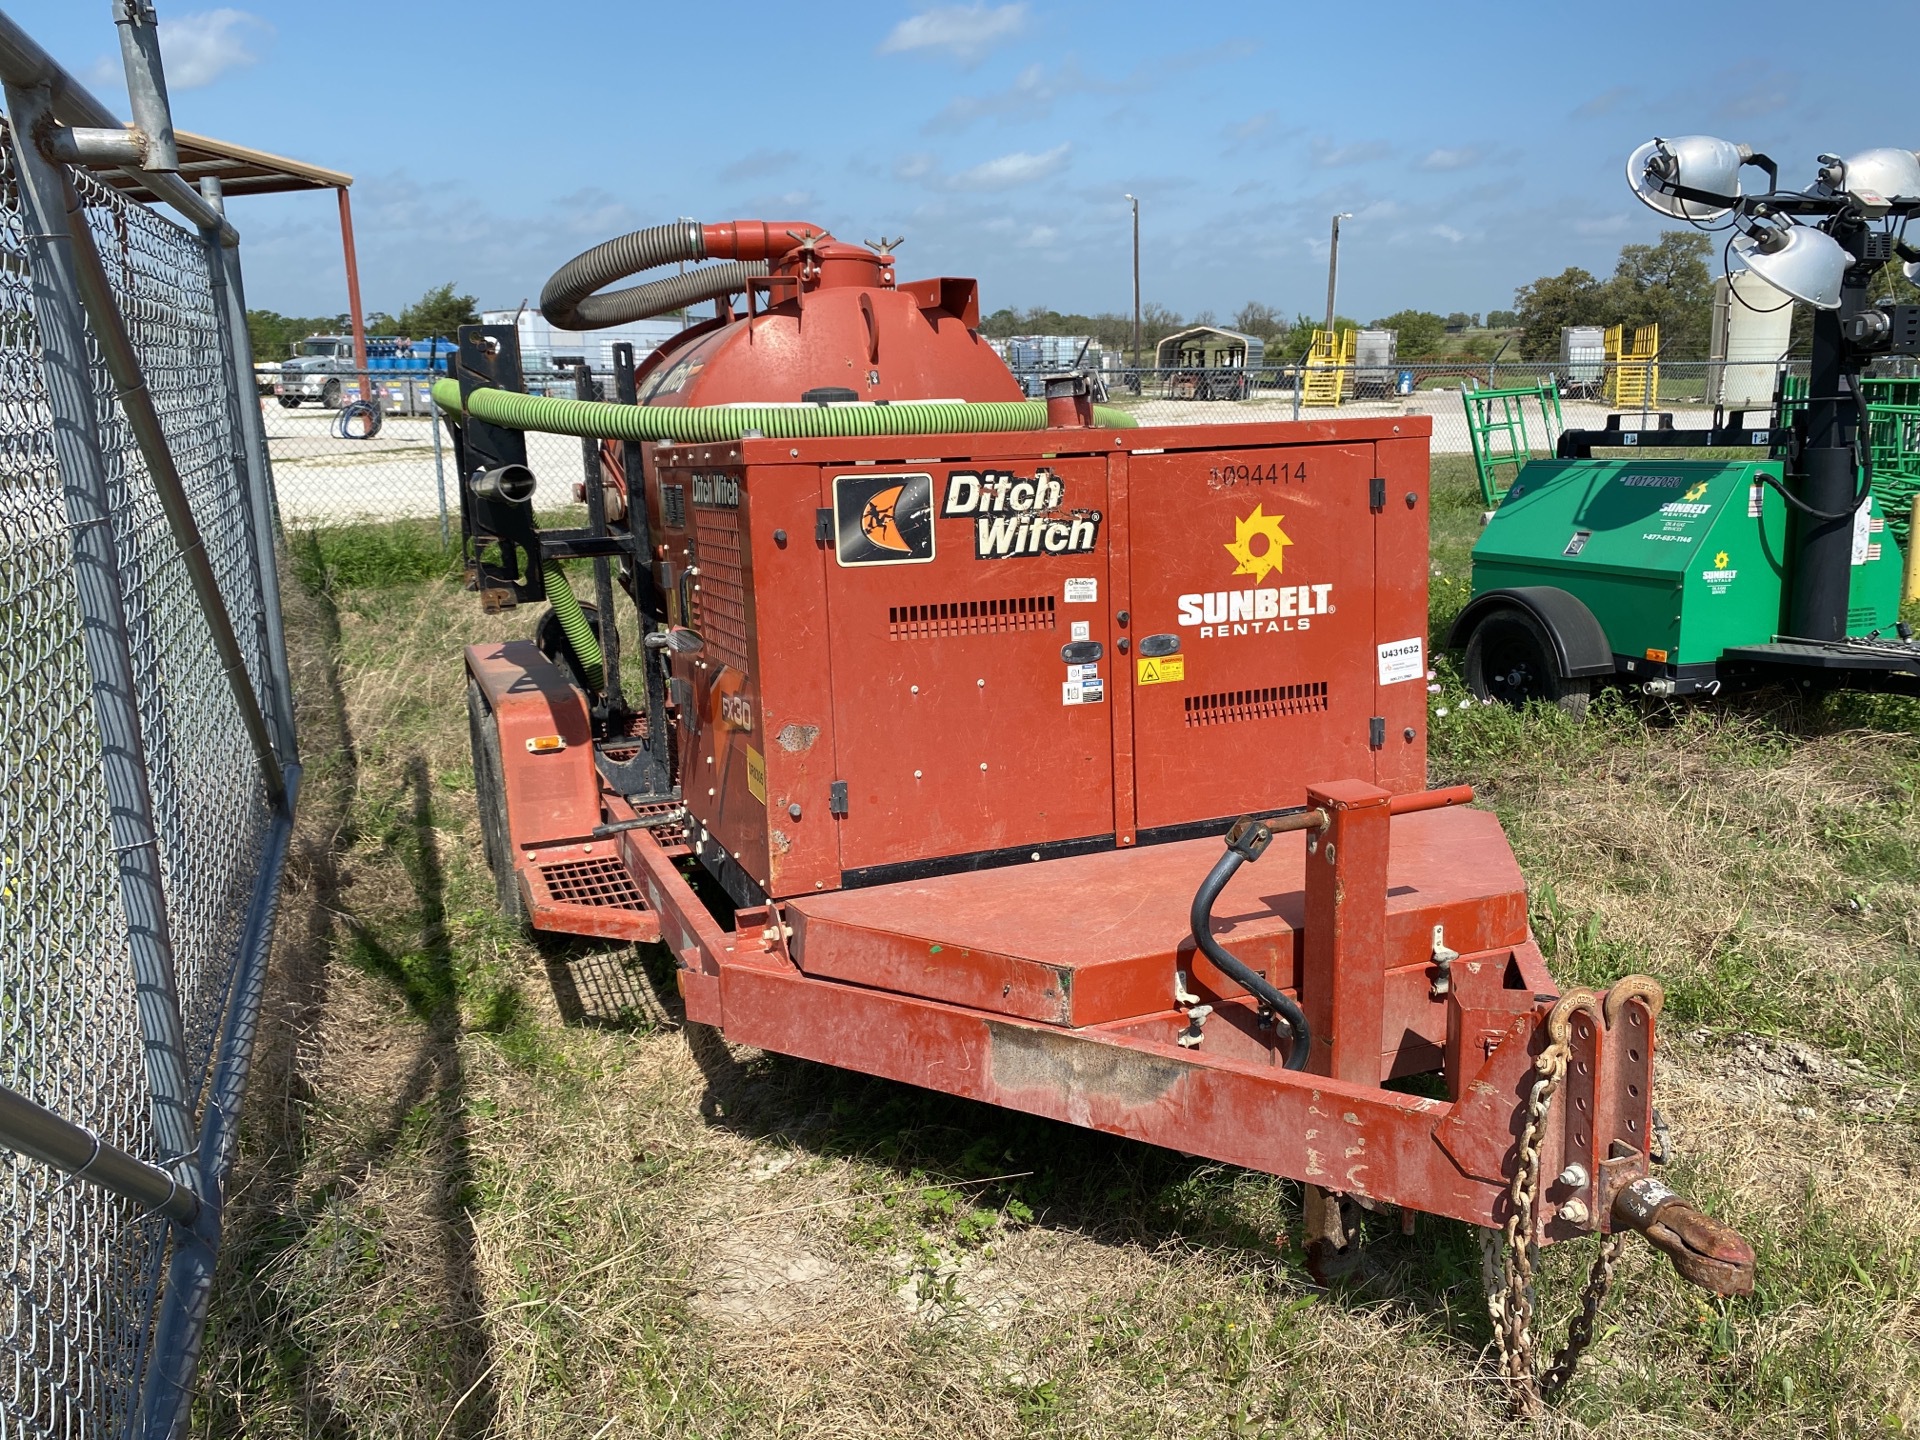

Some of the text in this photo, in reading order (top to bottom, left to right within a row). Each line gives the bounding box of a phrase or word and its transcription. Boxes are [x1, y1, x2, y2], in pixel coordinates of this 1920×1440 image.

[692, 475, 739, 505] Ditch Witch
[945, 472, 1061, 513] Ditch
[1659, 502, 1712, 514] SUNBELT
[1702, 570, 1738, 580] SUNBELT
[1200, 617, 1311, 639] RENTALS
[1381, 644, 1419, 659] U431632
[722, 696, 751, 731] FX30
